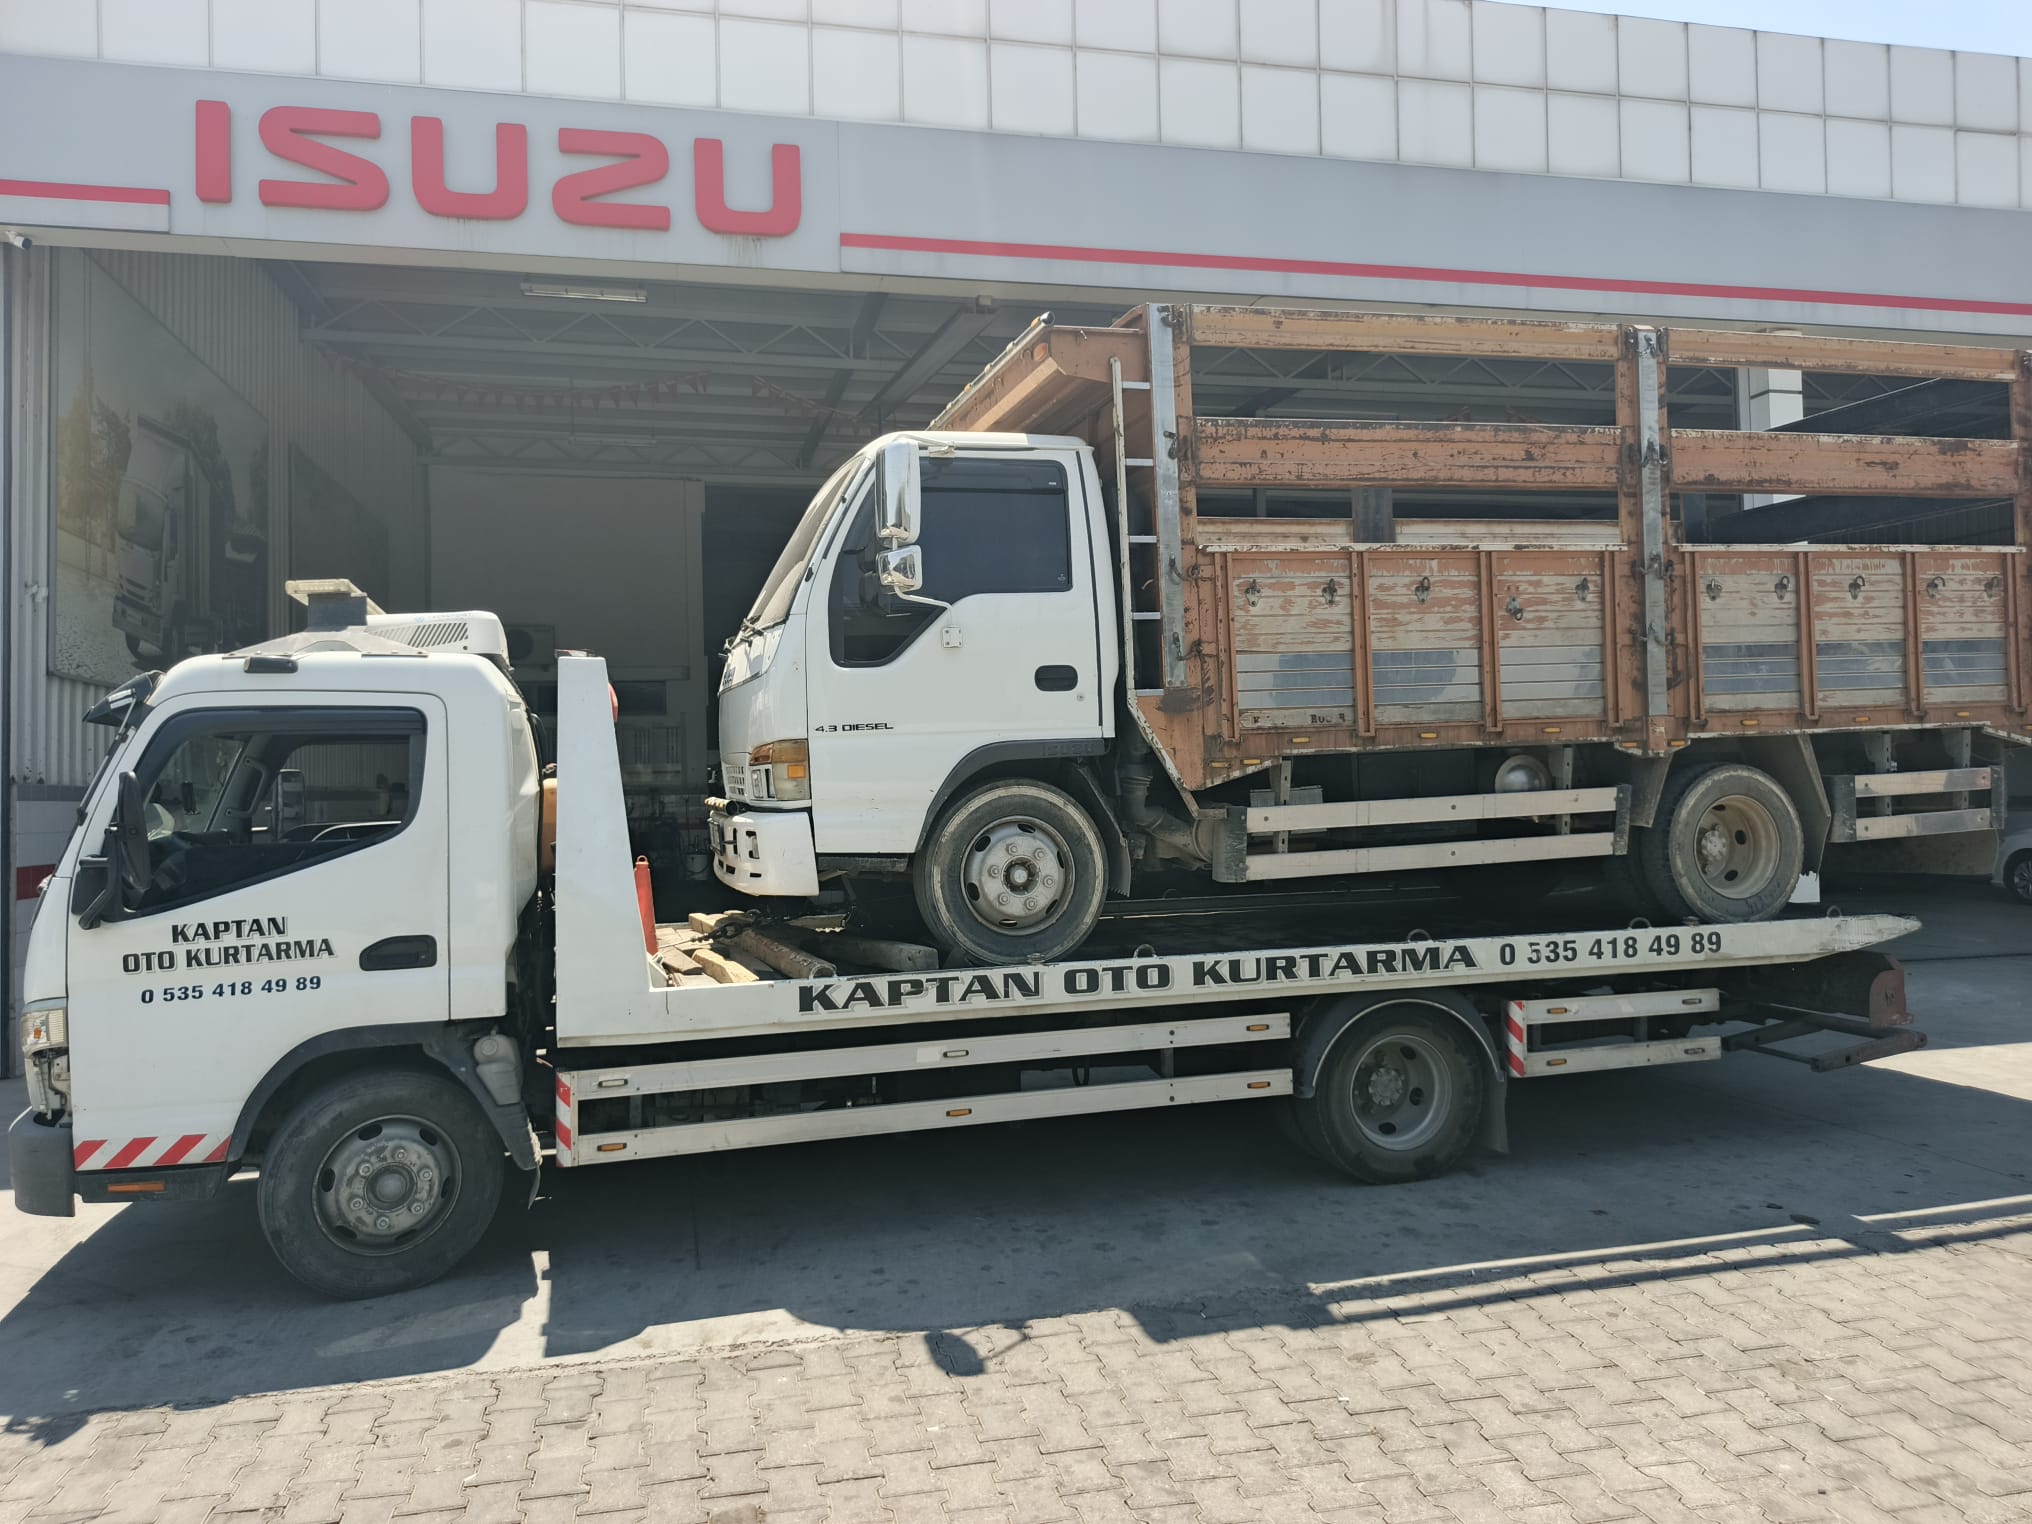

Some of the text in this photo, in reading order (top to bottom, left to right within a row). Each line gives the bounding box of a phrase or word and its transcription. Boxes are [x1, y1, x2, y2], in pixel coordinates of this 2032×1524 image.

[195, 99, 801, 238] ISUZU
[815, 722, 894, 733] 4.3 DIESEL
[171, 916, 288, 945] KAPTAN
[122, 938, 336, 974] OTO KURTARMA
[799, 931, 1722, 1013] KAPTAN OTO KURTARMA 0 535 418 49 89
[140, 975, 321, 1004] 0 535 418 49 89
